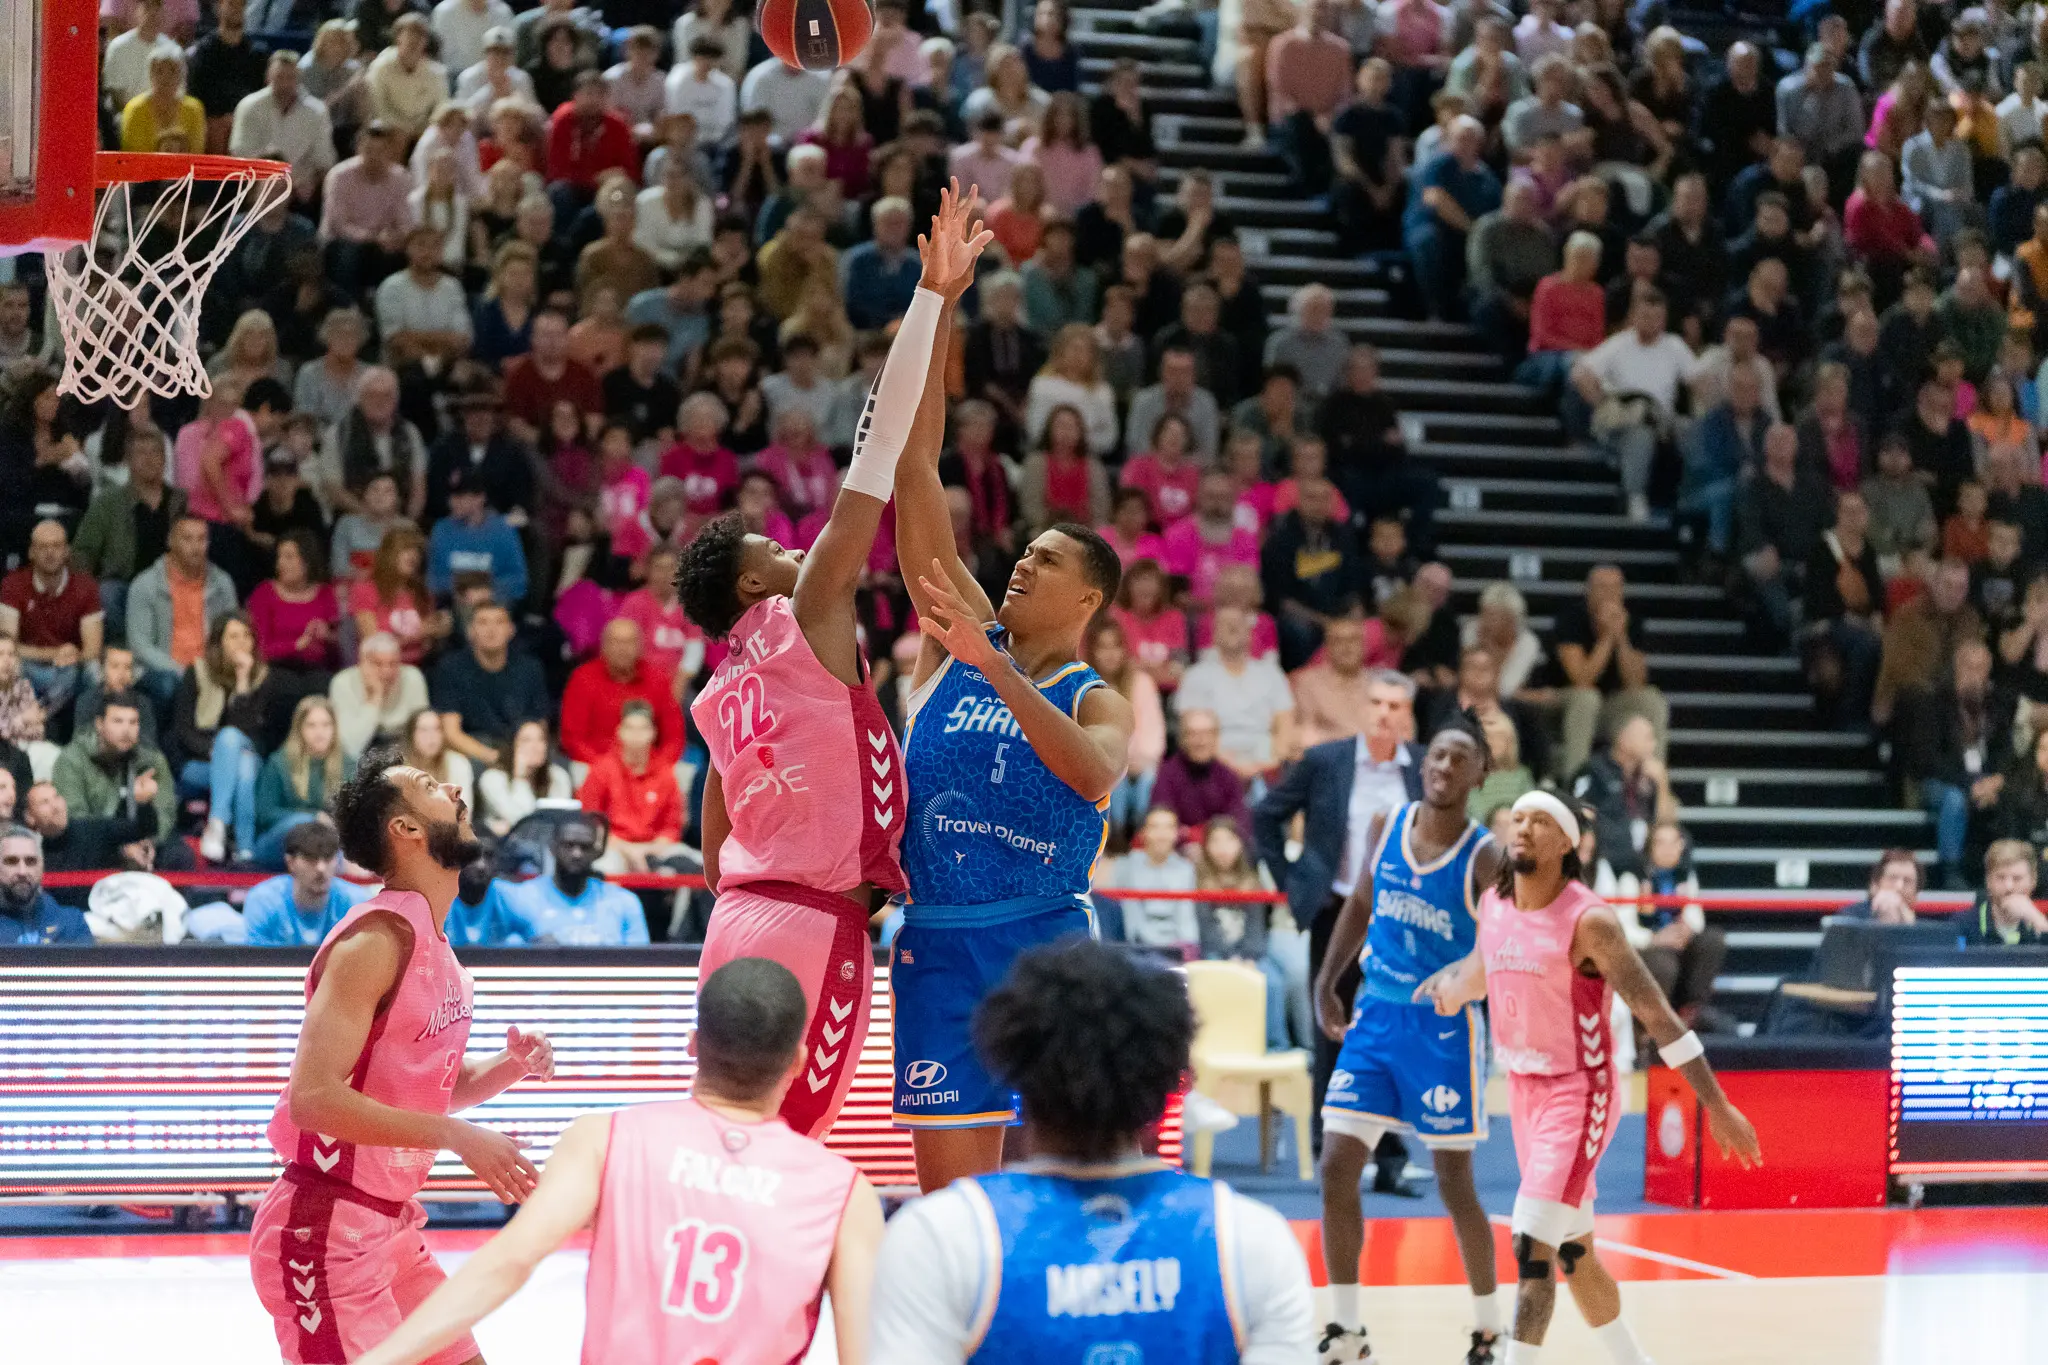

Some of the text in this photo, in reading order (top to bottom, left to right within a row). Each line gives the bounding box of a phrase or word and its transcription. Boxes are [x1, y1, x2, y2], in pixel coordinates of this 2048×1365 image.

[718, 672, 777, 759] 22
[990, 742, 1011, 784] 5
[934, 814, 1058, 857] Travel Planet
[900, 1089, 960, 1107] HYUNDAI
[660, 1215, 750, 1324] 13
